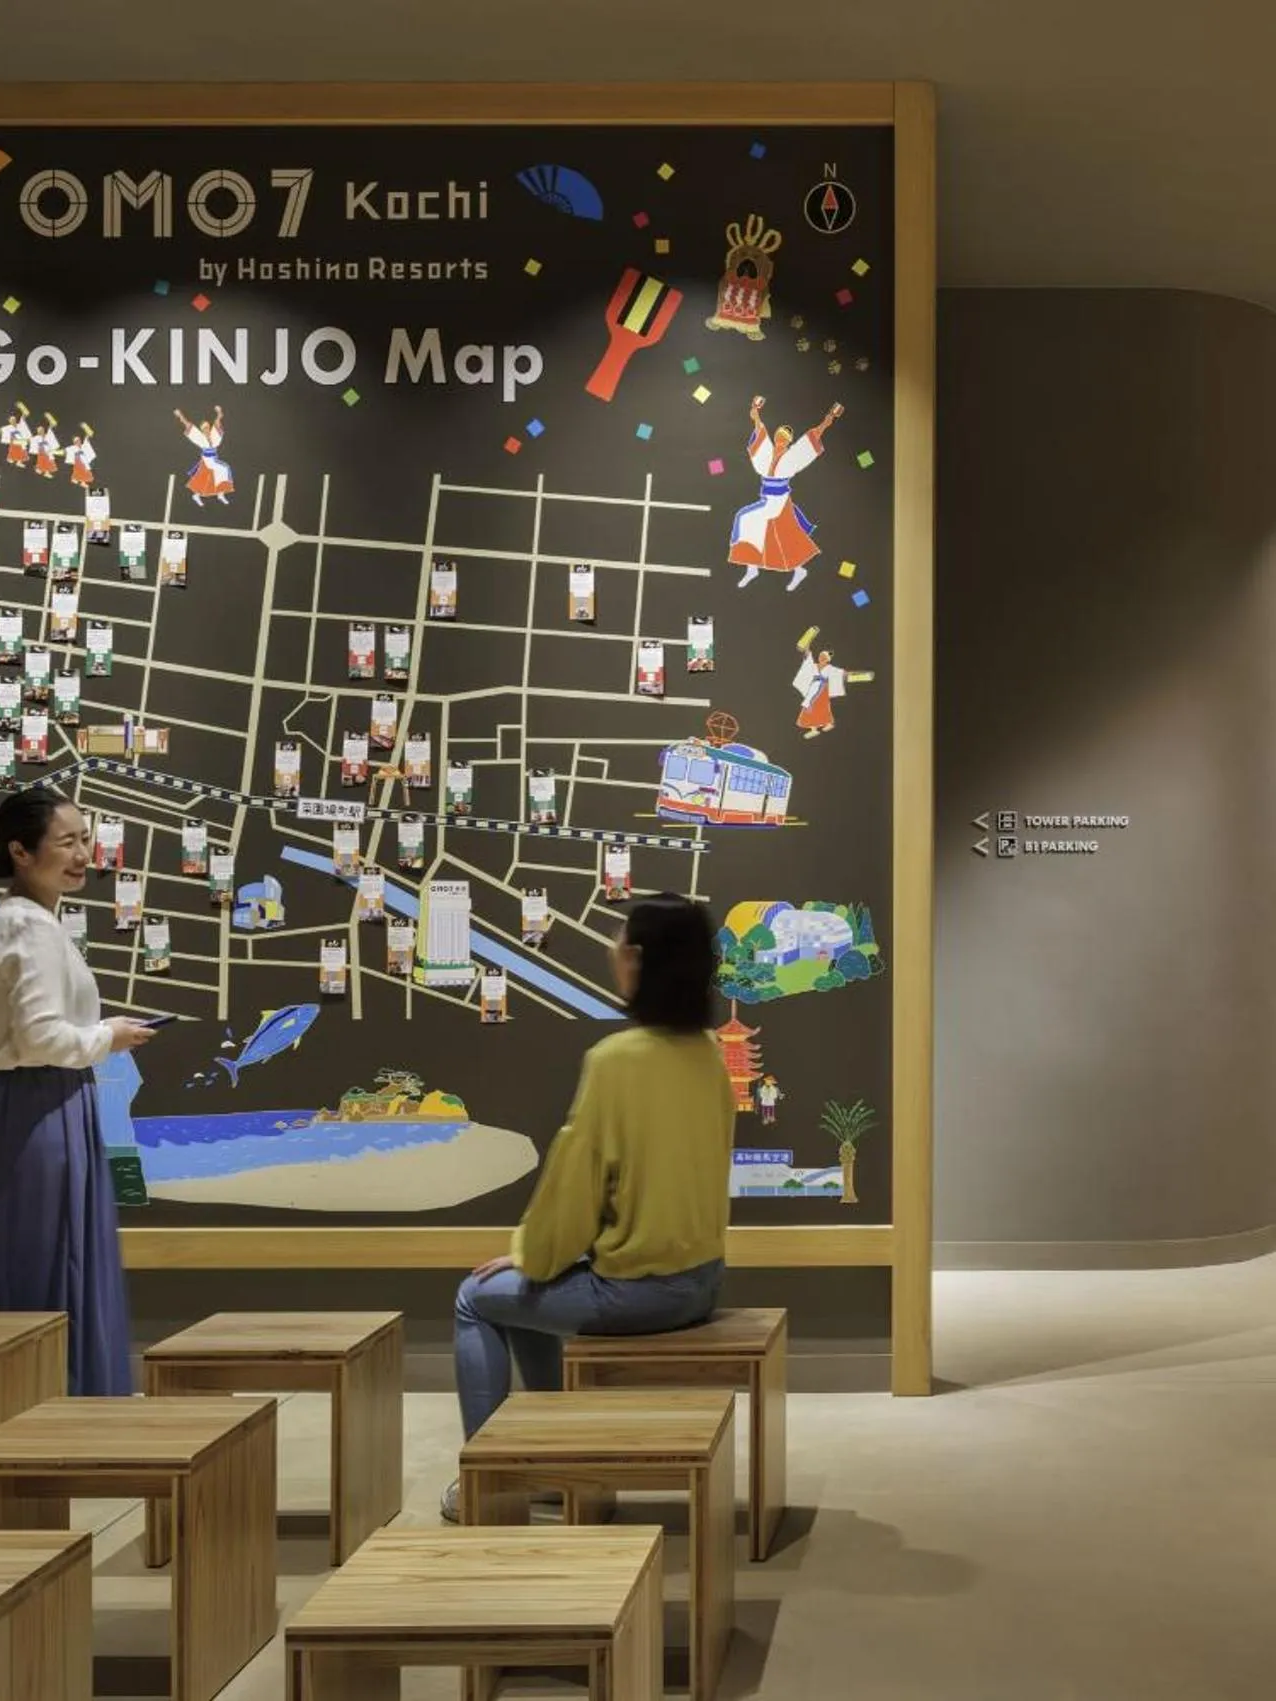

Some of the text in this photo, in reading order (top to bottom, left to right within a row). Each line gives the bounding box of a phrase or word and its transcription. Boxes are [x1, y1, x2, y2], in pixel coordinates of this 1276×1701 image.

[824, 163, 836, 177] N
[20, 168, 488, 238] OMO7 Kochi
[199, 257, 488, 286] by Hoshino Resorts
[384, 327, 543, 402] Map
[303, 803, 361, 818] 菜園場町駅
[1025, 815, 1129, 826] TOWER PARKING
[1041, 840, 1099, 852] PARKING
